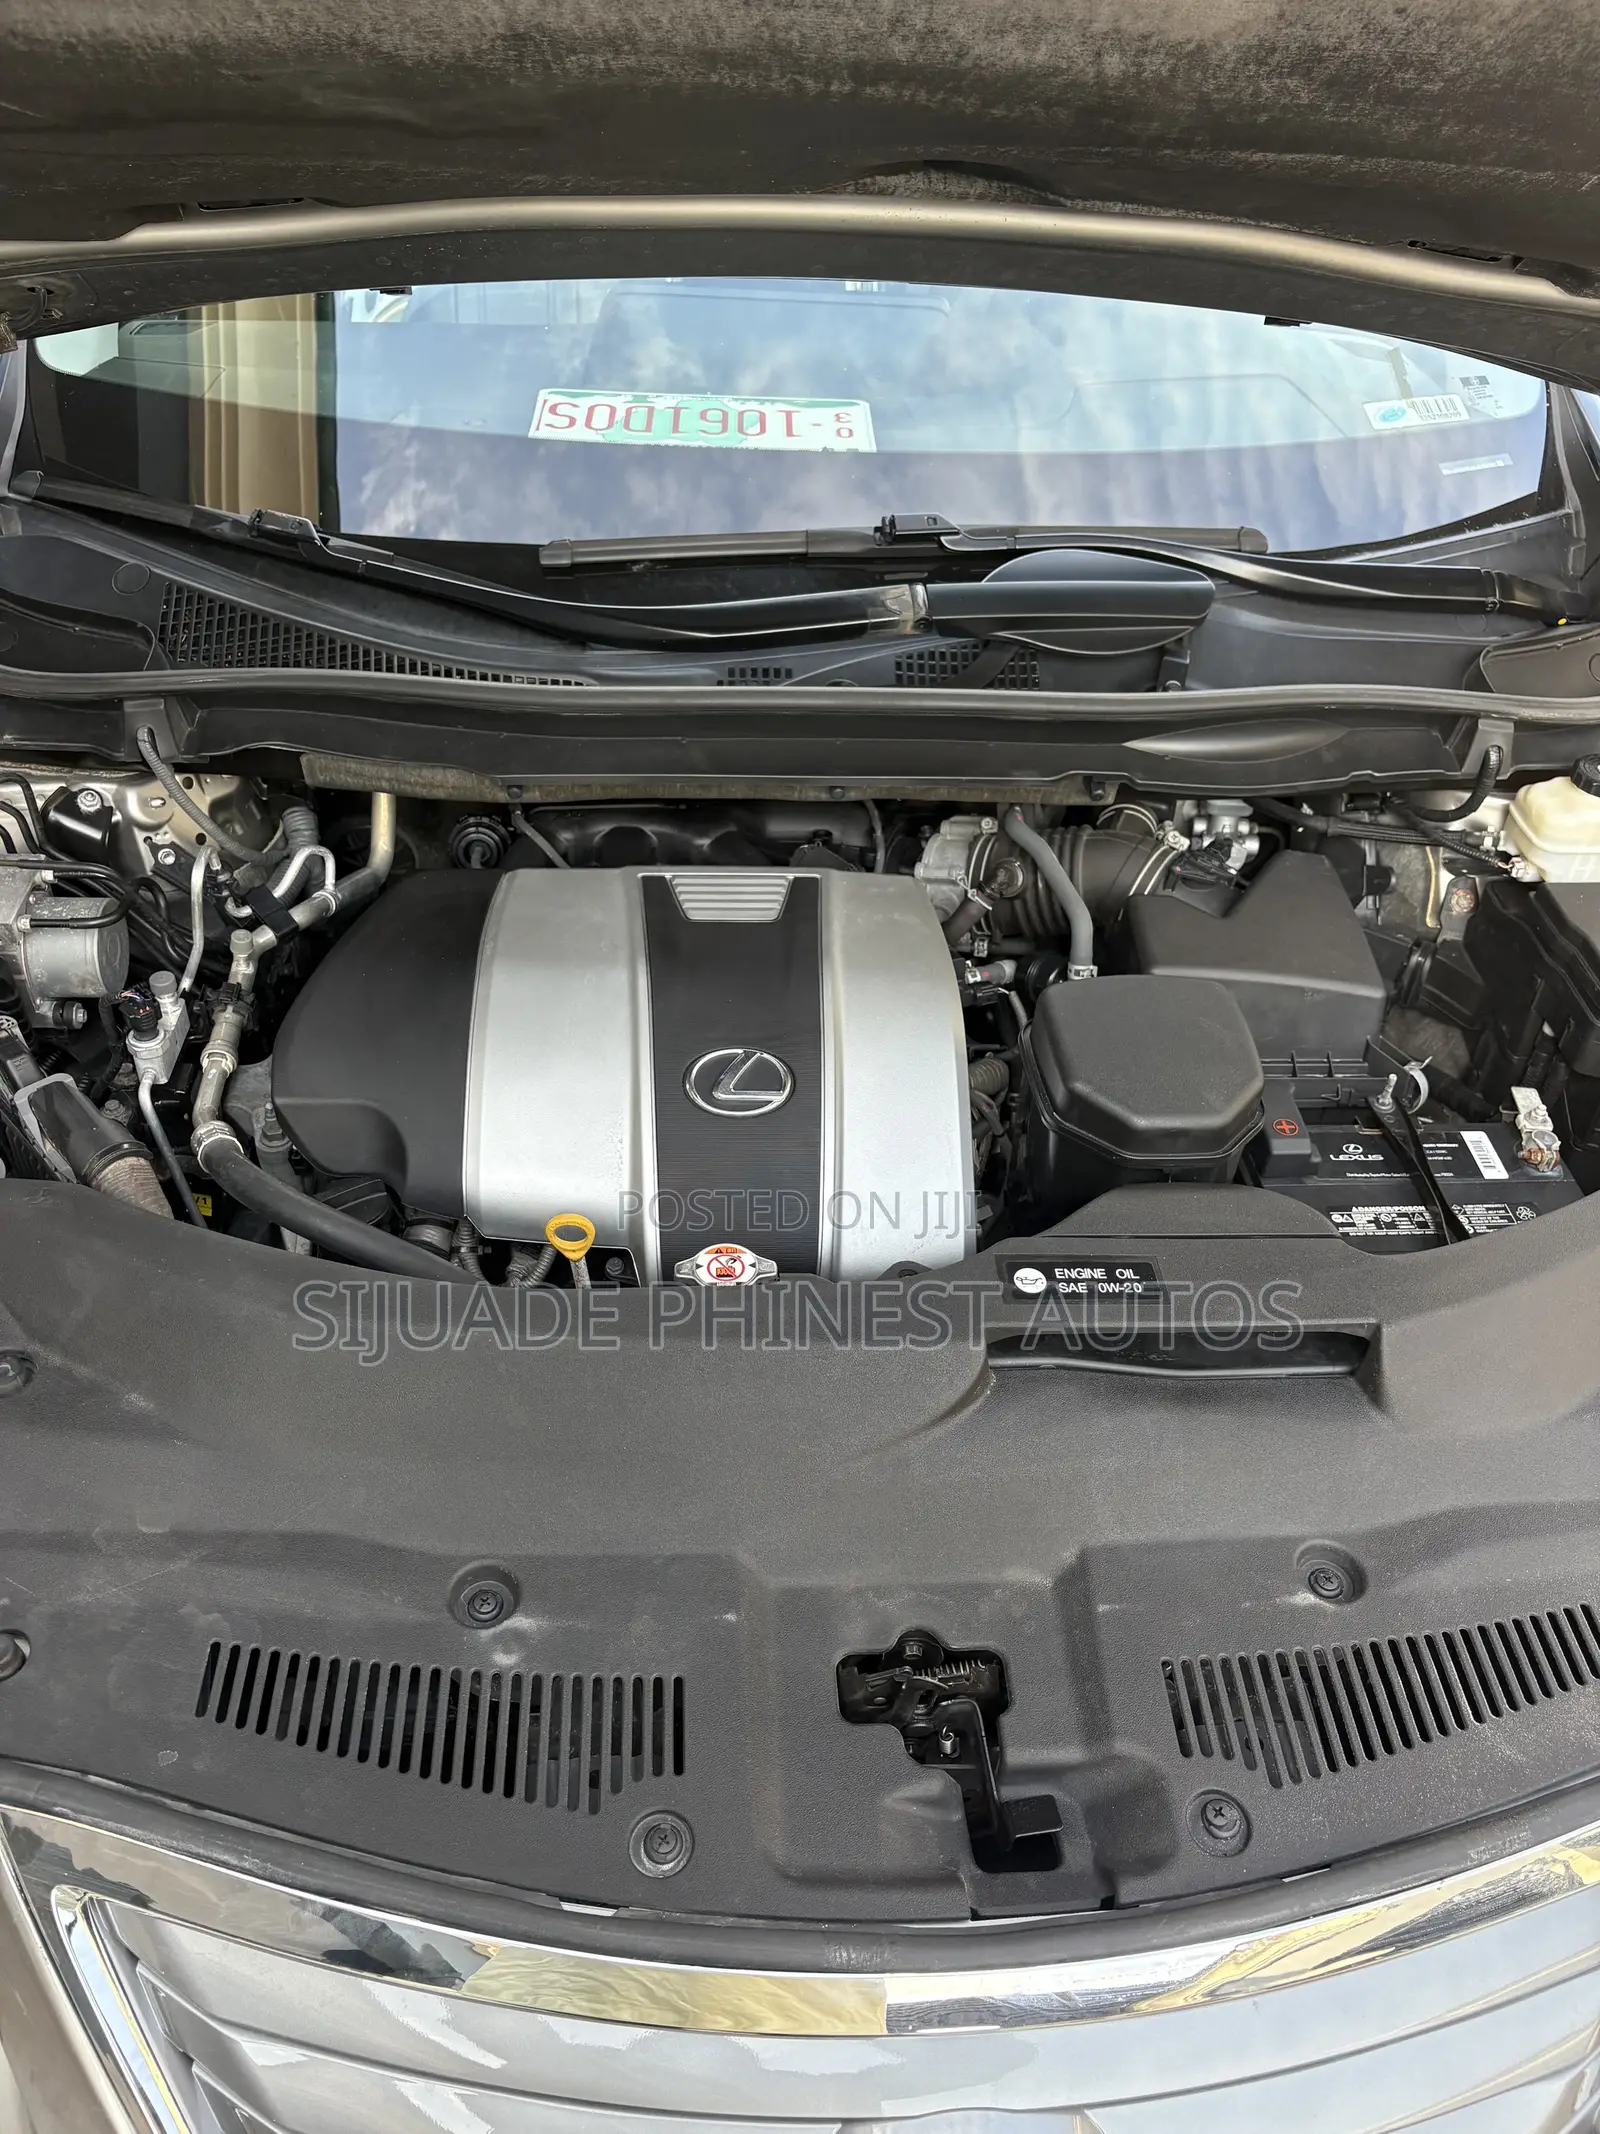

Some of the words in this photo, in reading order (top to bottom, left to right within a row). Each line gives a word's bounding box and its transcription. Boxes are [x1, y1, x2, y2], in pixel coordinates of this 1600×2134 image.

[1054, 1268, 1107, 1279] ENGINE
[1115, 1268, 1140, 1279] OIL
[1058, 1282, 1088, 1293] SAE
[1098, 1282, 1142, 1293] 0W-20
